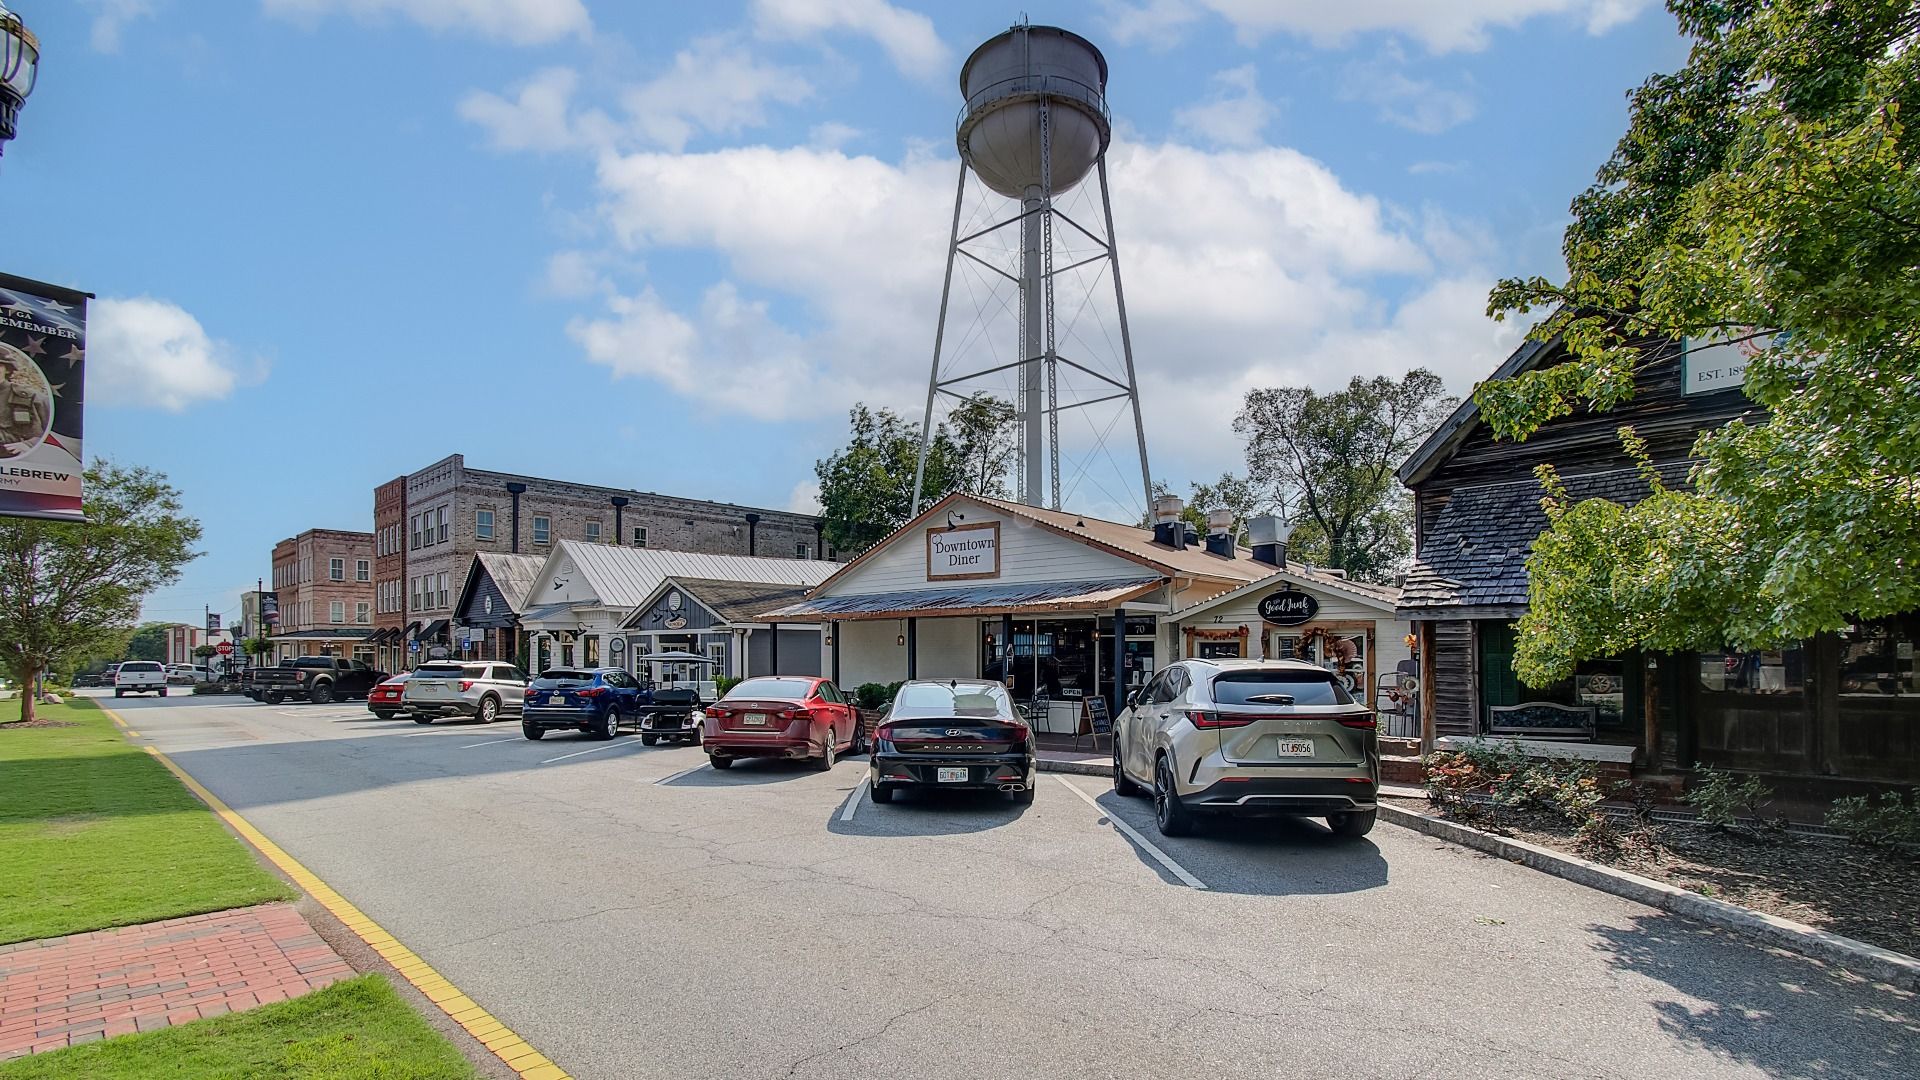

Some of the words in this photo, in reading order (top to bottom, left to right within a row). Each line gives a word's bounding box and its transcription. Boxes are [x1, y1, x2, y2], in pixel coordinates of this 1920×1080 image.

[1698, 368, 1724, 382] EST.
[1729, 364, 1747, 377] 189
[0, 466, 69, 481] LEBREW
[936, 539, 996, 554] Downtown
[949, 554, 980, 566] Diner
[1287, 597, 1310, 612] Junk
[1214, 615, 1224, 624] 72
[1135, 625, 1145, 634] 70
